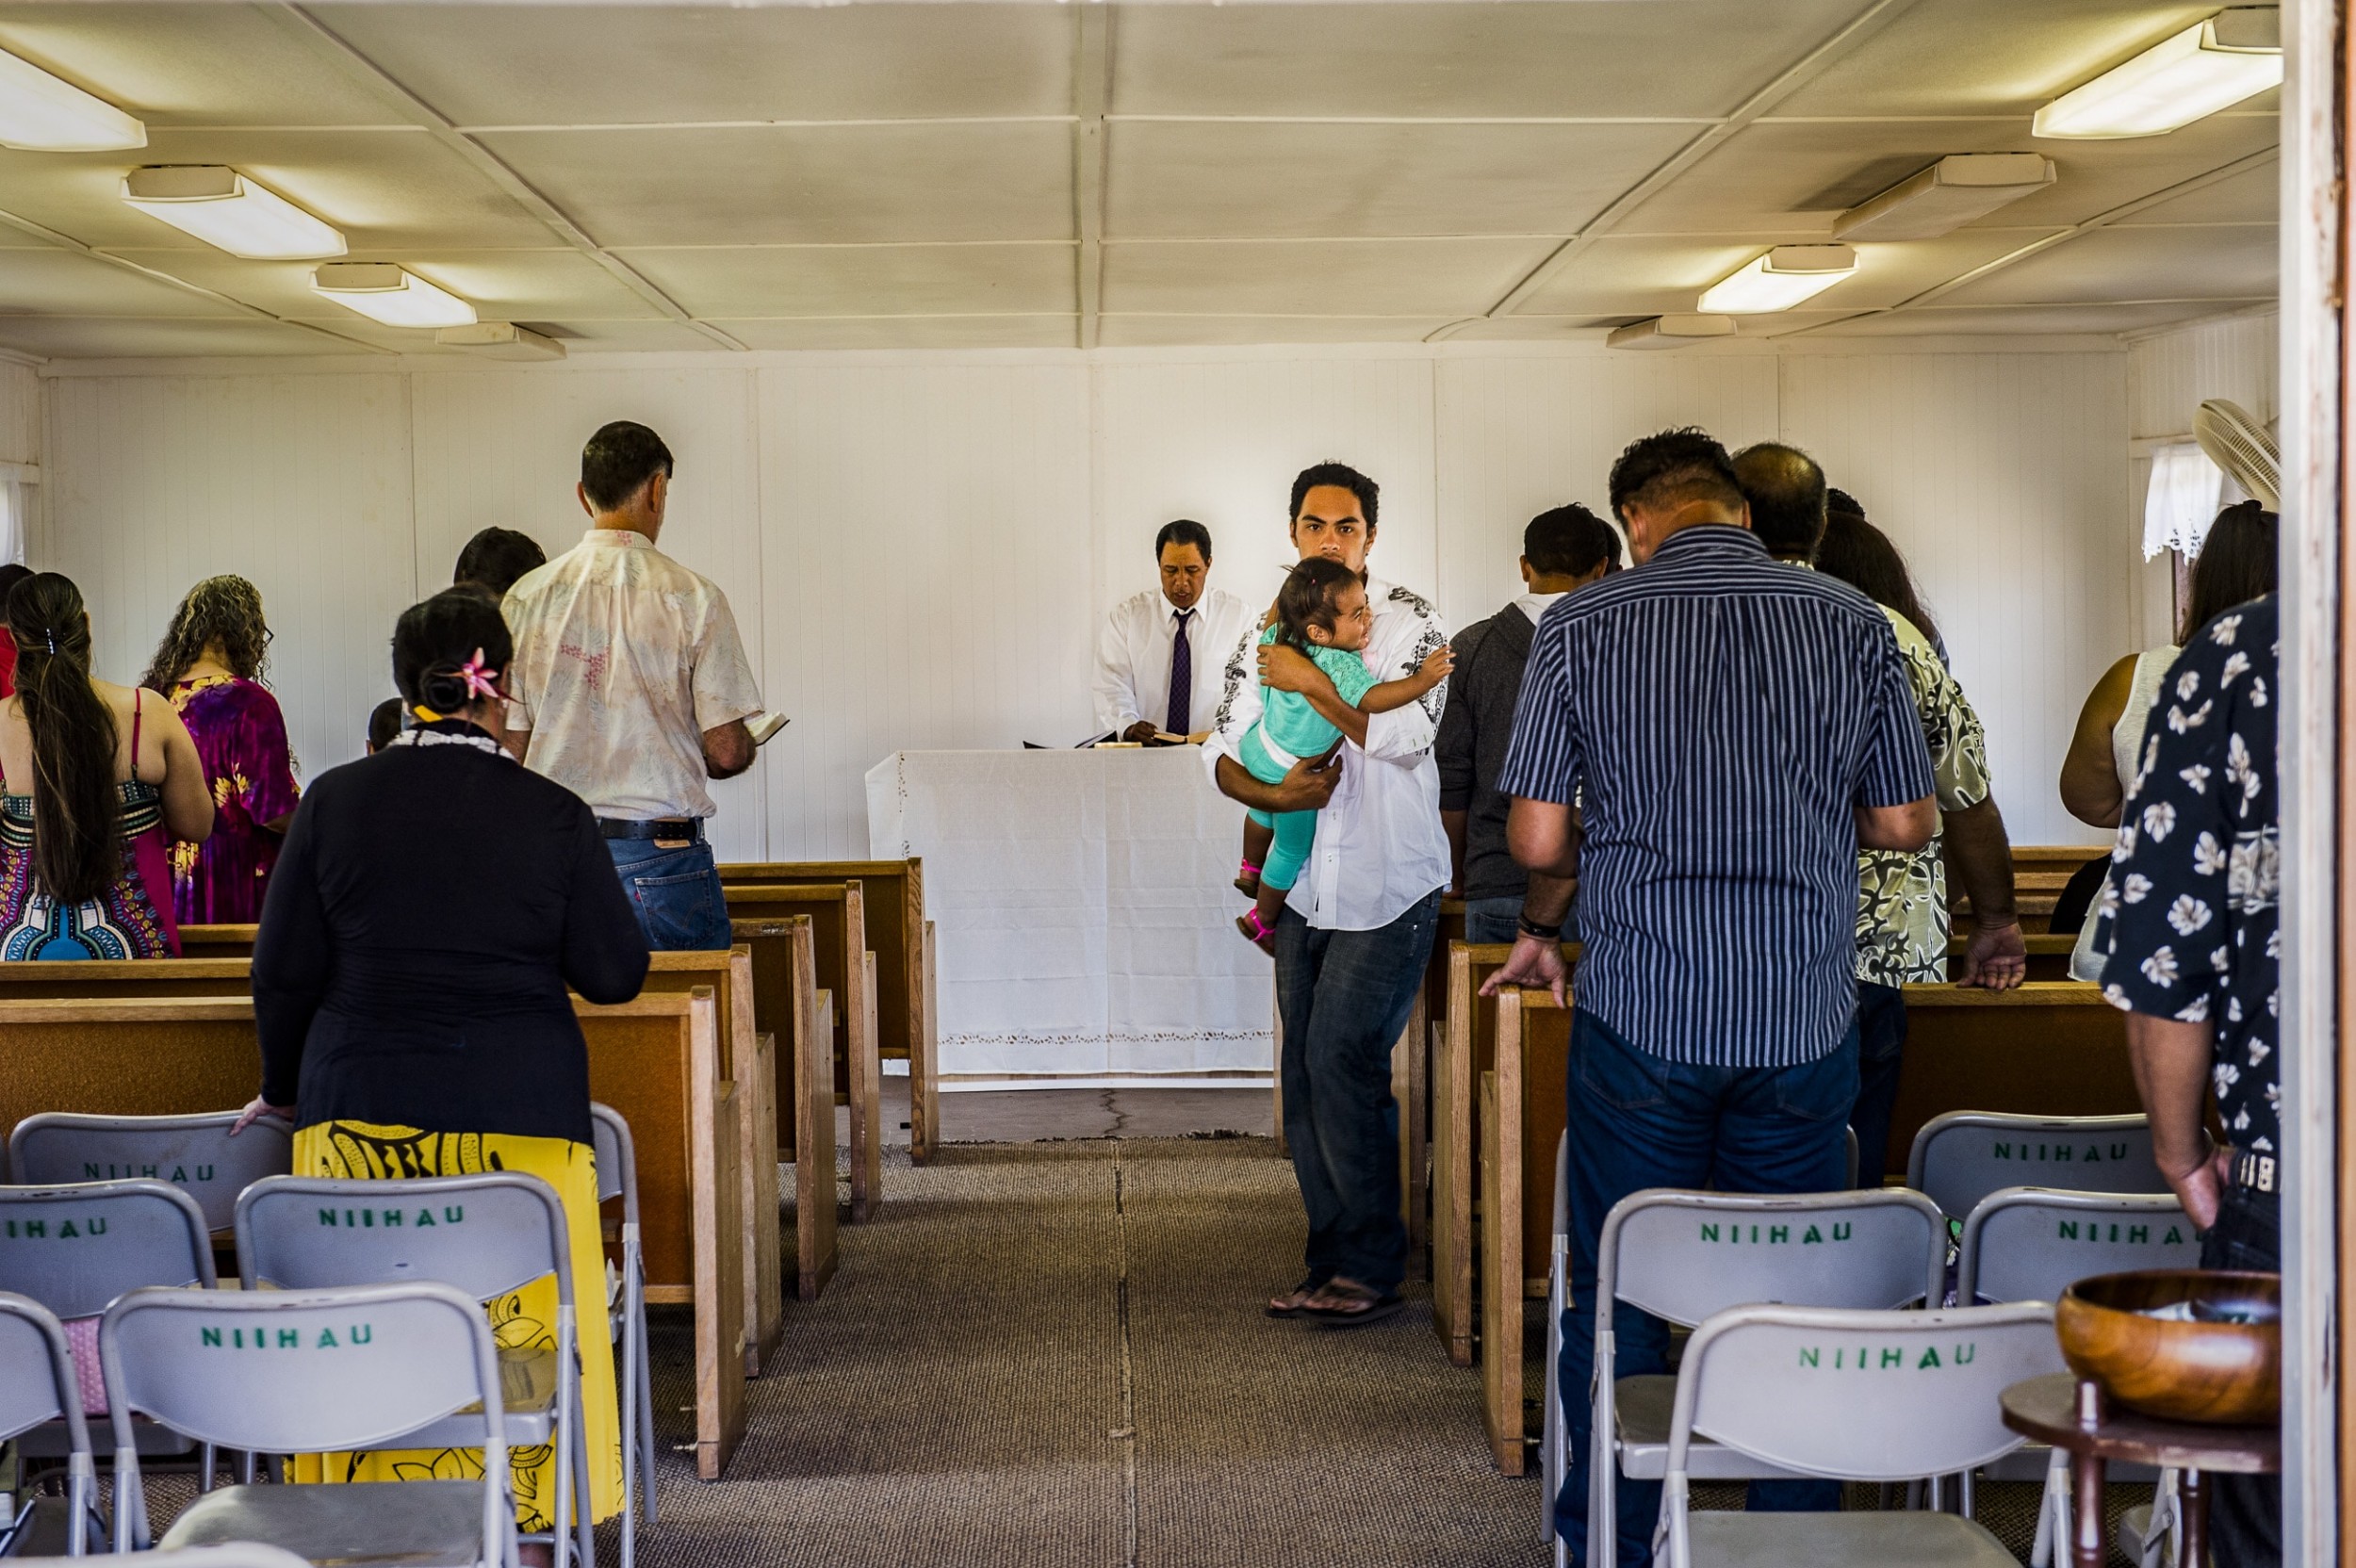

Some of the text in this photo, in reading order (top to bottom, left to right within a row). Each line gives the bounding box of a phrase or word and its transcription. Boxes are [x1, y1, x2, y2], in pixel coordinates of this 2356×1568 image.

[1993, 1142, 2127, 1162] NIIHAU
[84, 1162, 214, 1183] NIIHAU
[319, 1205, 464, 1227] NIIHAU
[1701, 1222, 1851, 1244] NIIHAU
[201, 1324, 372, 1349] NIIHAU
[1799, 1343, 1976, 1369] NIIHAU
